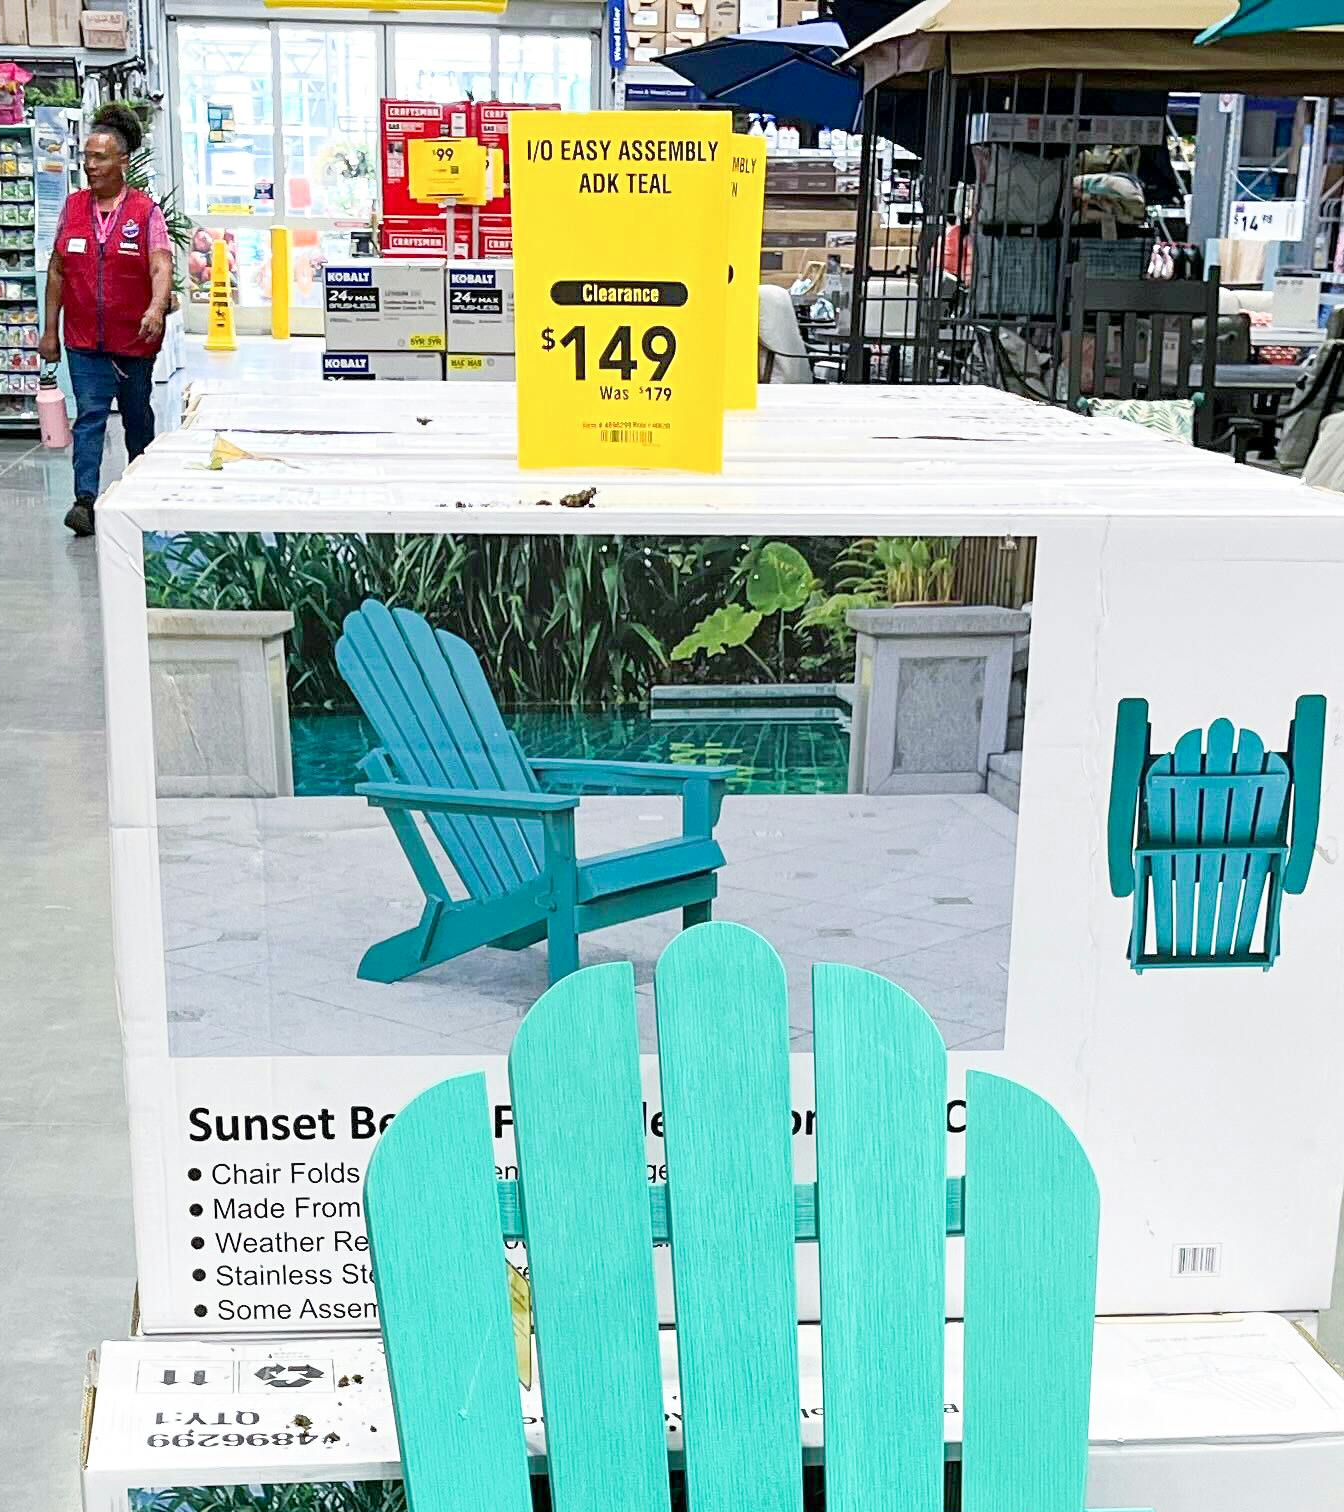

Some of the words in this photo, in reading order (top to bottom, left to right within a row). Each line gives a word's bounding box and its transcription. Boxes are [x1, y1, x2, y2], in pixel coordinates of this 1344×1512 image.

[389, 107, 440, 117] CRAFTSMAN
[527, 139, 553, 163] I/O
[561, 140, 611, 160] EASY
[619, 140, 718, 161] ASSEMBLY
[732, 157, 757, 173] MBLY
[579, 173, 619, 193] ADK
[626, 173, 672, 194] TEAL
[393, 237, 442, 247] CRAFTSMAN
[327, 272, 369, 282] KOBALT
[451, 274, 494, 284] KOBALT
[582, 283, 660, 303] Clearance
[325, 358, 366, 368] KOBALT
[541, 325, 677, 382] $149
[600, 386, 629, 400] Was
[639, 386, 672, 401] $179
[189, 1106, 336, 1142] Sunset
[212, 1162, 281, 1185] Chair
[291, 1161, 360, 1184] Folds
[214, 1198, 284, 1219] Made
[296, 1197, 361, 1218] From
[215, 1231, 325, 1253] Weather
[216, 1265, 332, 1286] Stainless
[218, 1300, 291, 1320] Some
[299, 1298, 379, 1319] Assem
